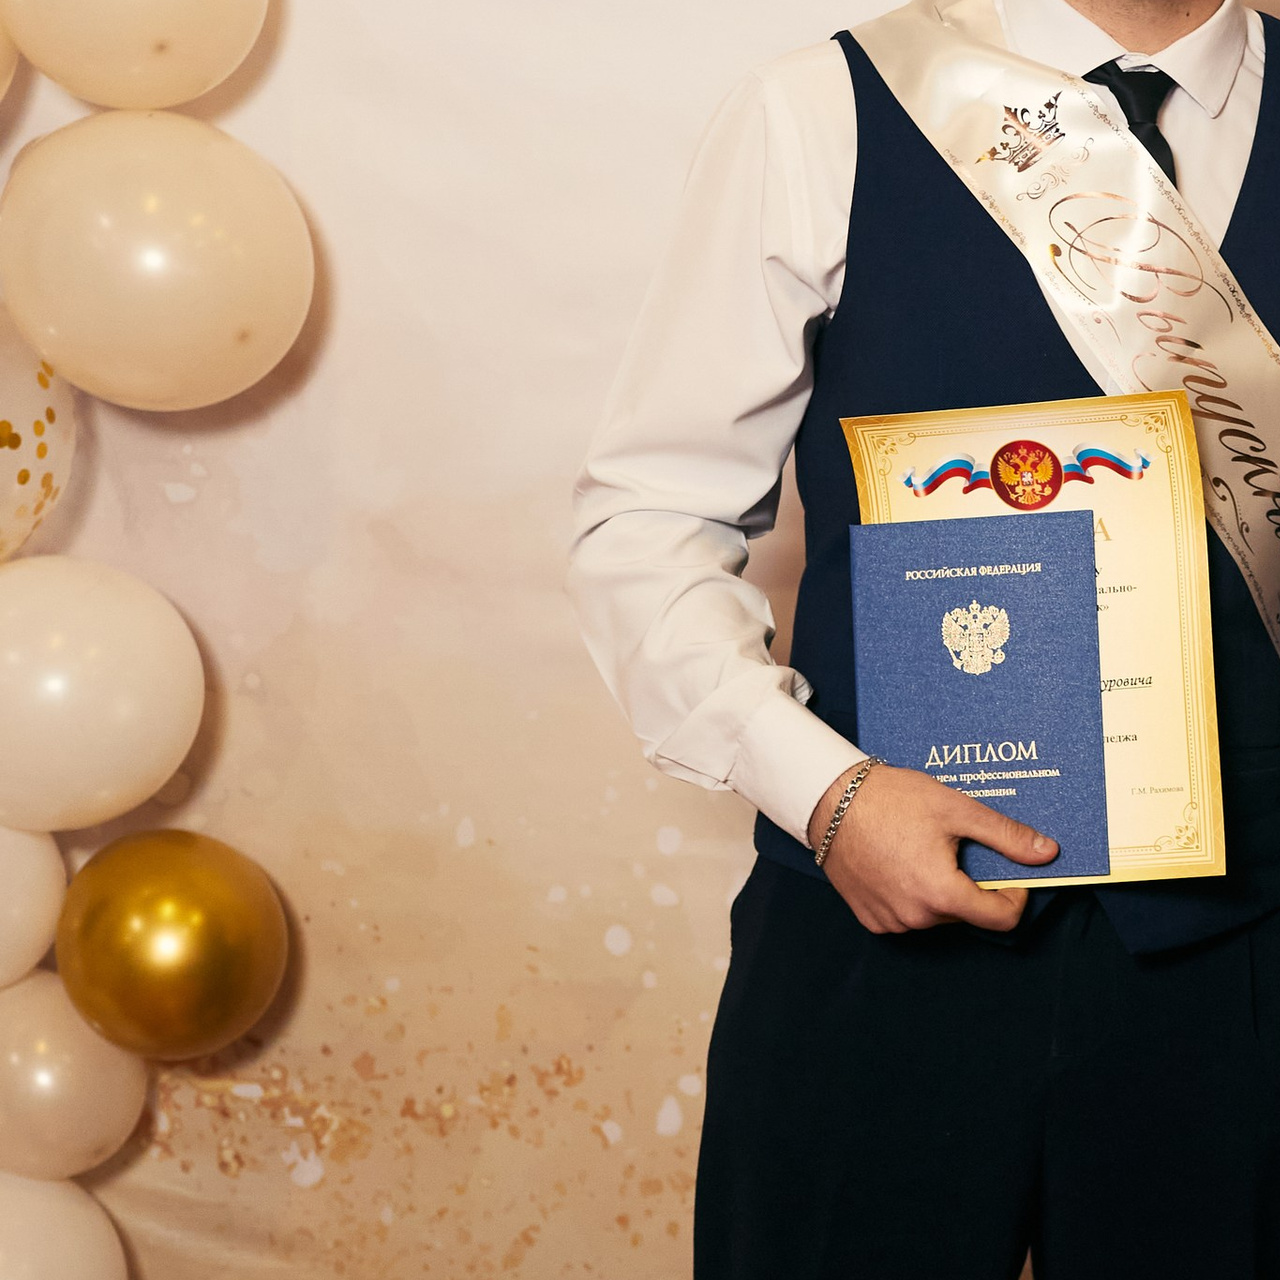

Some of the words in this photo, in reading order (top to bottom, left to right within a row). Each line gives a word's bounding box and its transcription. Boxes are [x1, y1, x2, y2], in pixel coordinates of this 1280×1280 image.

[905, 566, 978, 581] РОССИЙСКАЯ
[978, 562, 1042, 576] ФЕДЕРАЦИЯ
[925, 740, 1038, 769] ДИПЛОМ
[959, 769, 1060, 784] профессиональном
